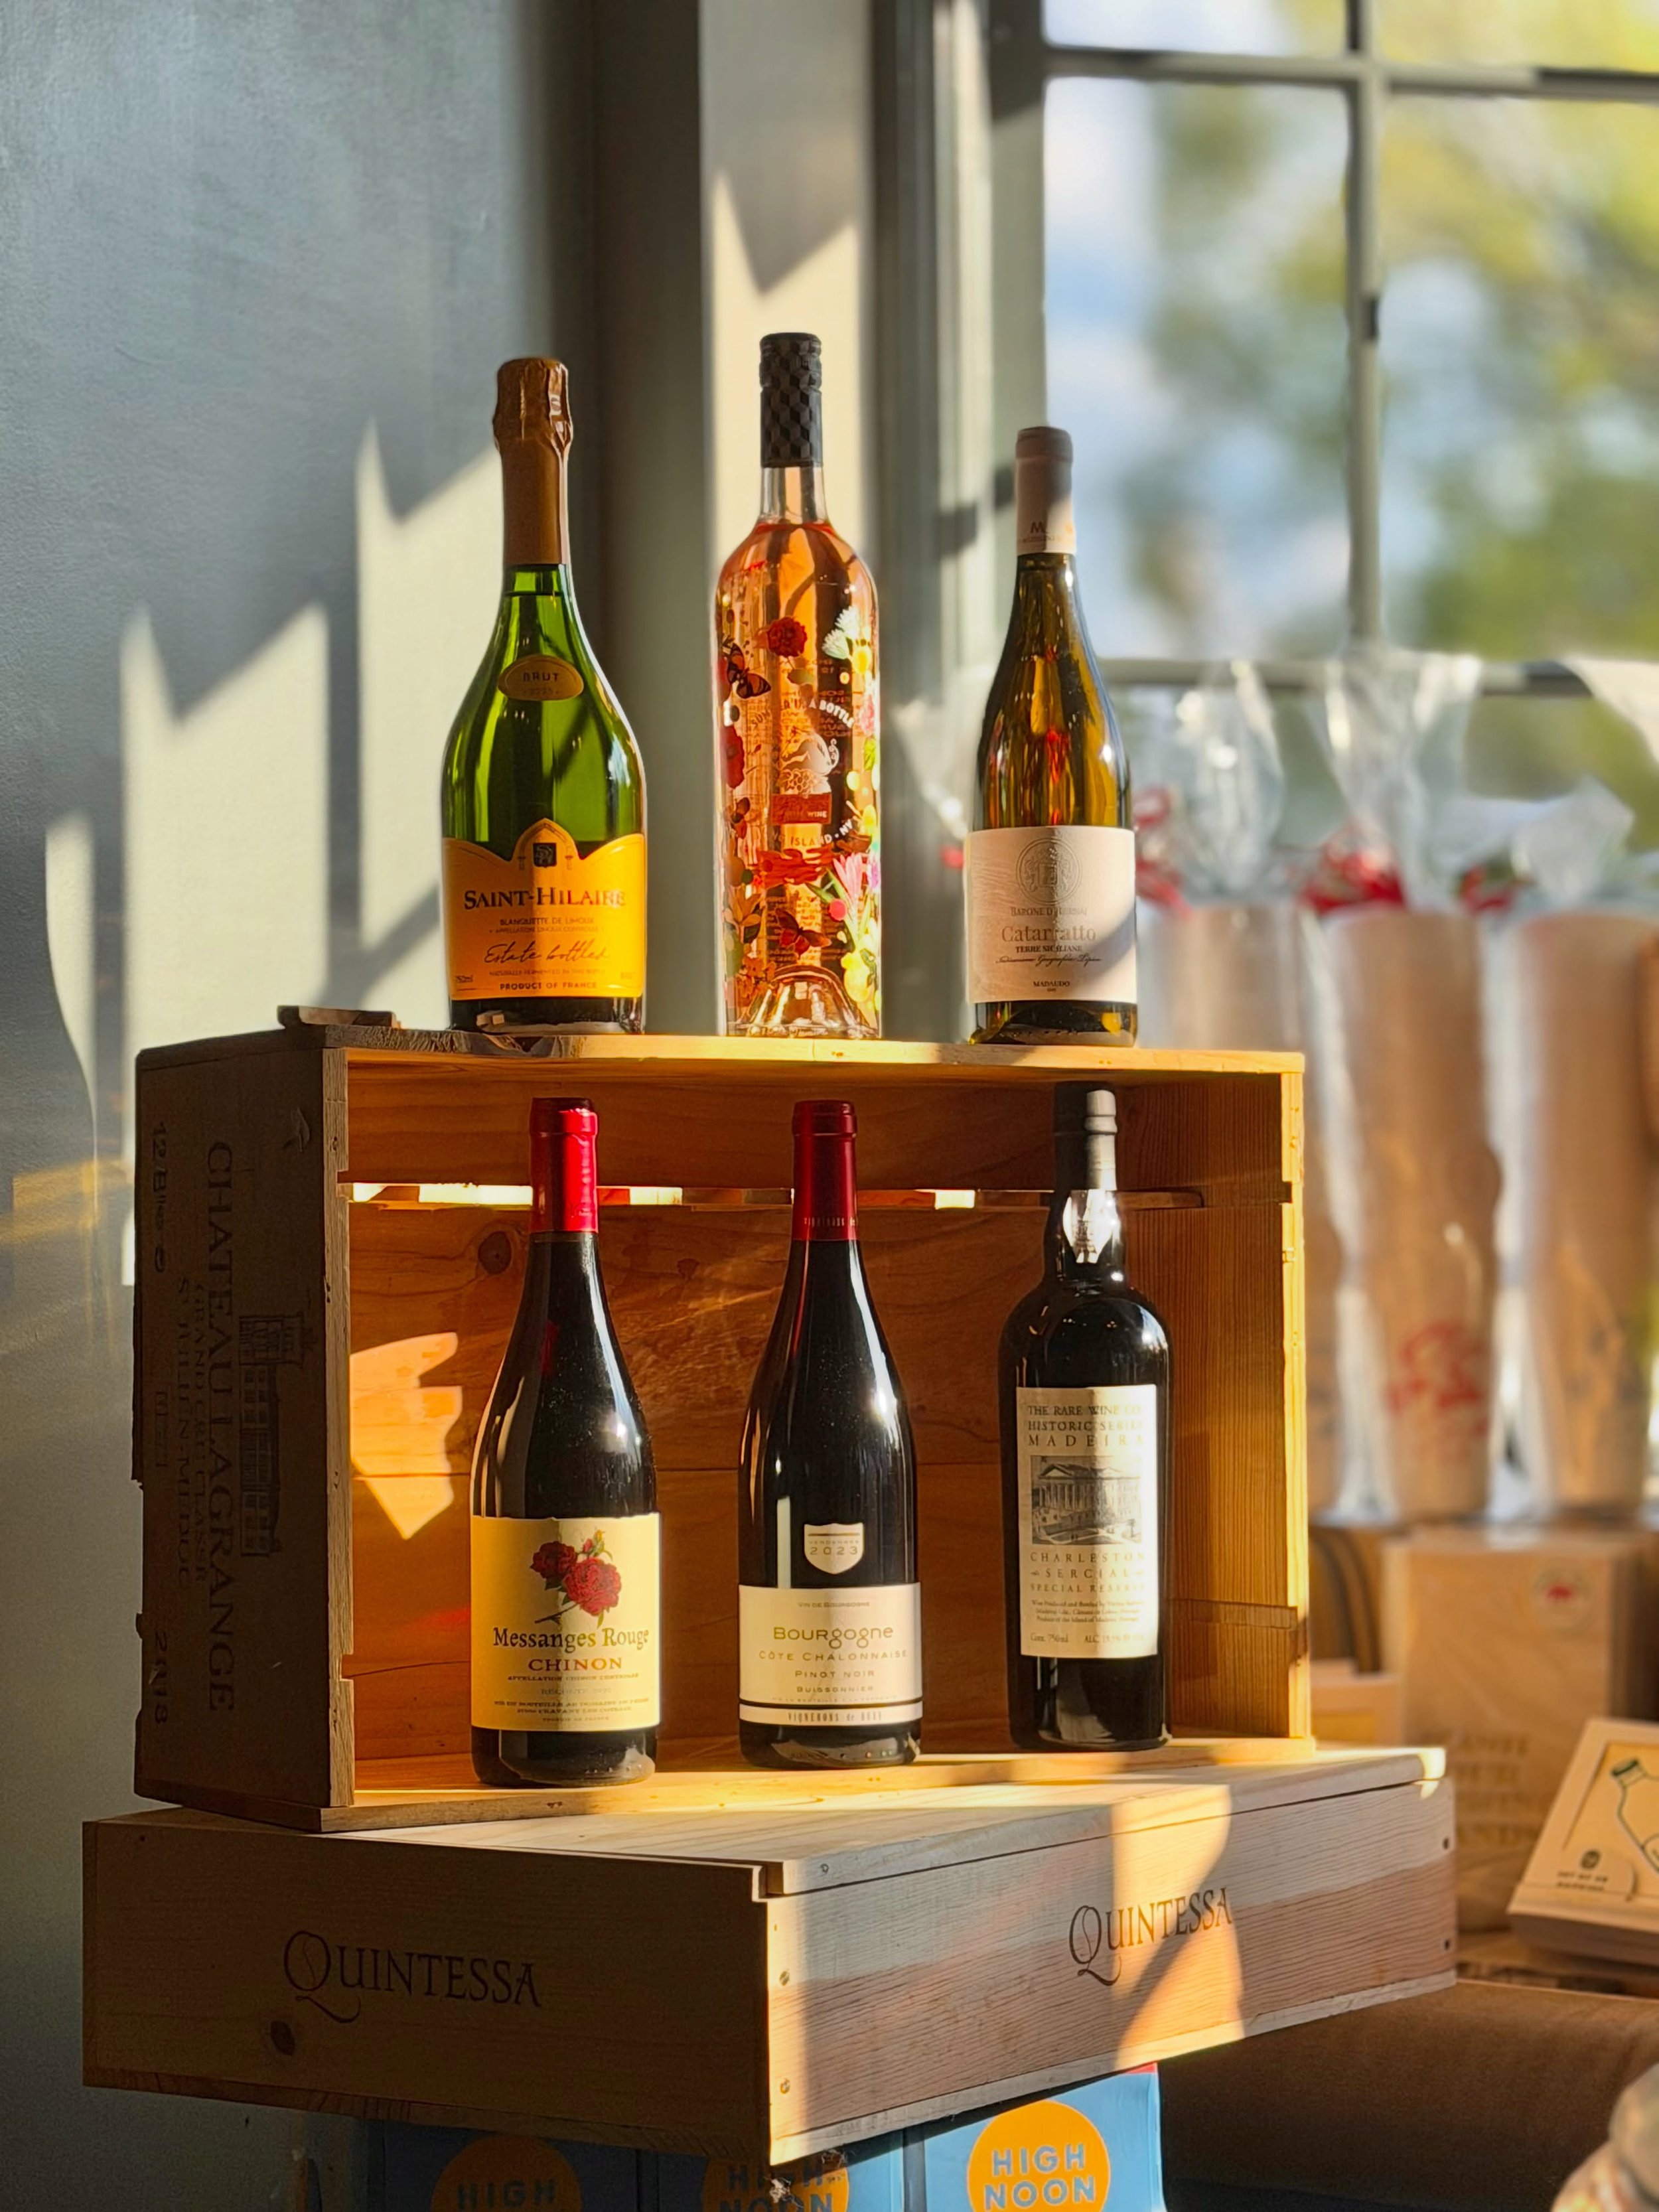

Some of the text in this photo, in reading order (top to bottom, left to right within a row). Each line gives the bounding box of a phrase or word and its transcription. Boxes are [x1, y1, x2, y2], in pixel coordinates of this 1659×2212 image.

[523, 672, 559, 682] BRUT
[819, 700, 854, 729] BOTTLE
[465, 887, 626, 910] SAINT-HILAIRE
[1001, 925, 1096, 942] Catarratto
[484, 938, 611, 964] Estate bottled
[1028, 1405, 1049, 1416] THE
[1054, 1405, 1082, 1416] RARE
[1088, 1404, 1119, 1415] WINE
[208, 1141, 235, 1712] CHATEAU LAGRANGE
[1028, 1420, 1093, 1432] HISTORIC
[810, 1546, 858, 1555] 2023
[1030, 1552, 1145, 1563] CHARLESTON
[1045, 1568, 1129, 1579] SERCIAL
[1030, 1584, 1082, 1593] SPECIAL
[493, 1627, 650, 1653] Messanges Rouge
[528, 1657, 622, 1672] CHINON
[802, 1649, 908, 1661] CHALONNAISE
[1068, 1887, 1233, 1986] QUINTESSA
[283, 1930, 542, 2024] QUINTESSA
[991, 2143, 1085, 2177] HIGH
[457, 2178, 557, 2211] HIGH
[984, 2175, 1094, 2211] NOON
